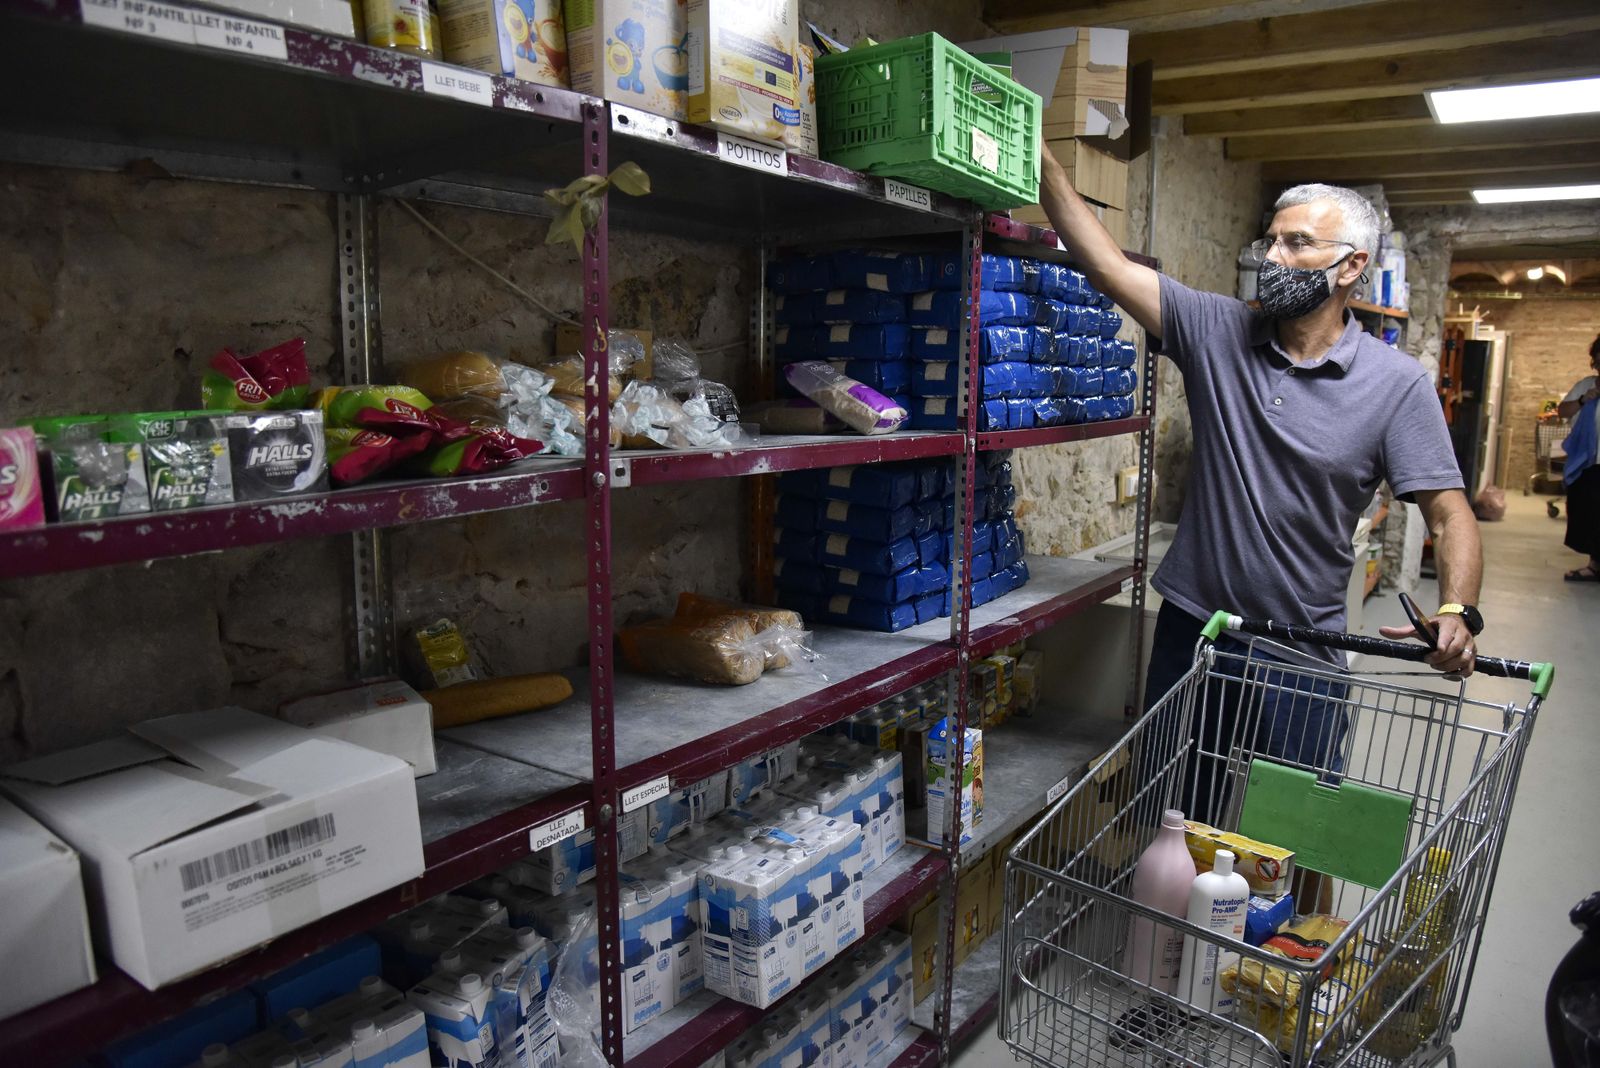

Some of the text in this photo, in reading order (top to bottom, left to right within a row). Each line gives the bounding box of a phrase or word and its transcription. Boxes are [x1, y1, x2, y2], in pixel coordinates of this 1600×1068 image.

[123, 1, 189, 25] INFANTIL
[191, 13, 282, 41] LLET INFANTIL
[246, 40, 253, 50] 4
[434, 74, 481, 93] LLET BEBE
[725, 140, 781, 169] POTITOS
[888, 183, 928, 206] PAPILLES
[151, 427, 171, 437] tac
[153, 420, 171, 430] tic
[248, 443, 313, 468] HALLS
[64, 491, 121, 509] HALLS
[158, 482, 207, 500] HALLS
[624, 782, 668, 806] LLET ESPECIAL
[549, 818, 566, 832] LLET
[536, 823, 580, 849] DESNATADA
[1211, 906, 1238, 914] Pro-AMP
[1212, 897, 1246, 907] Nutratopic
